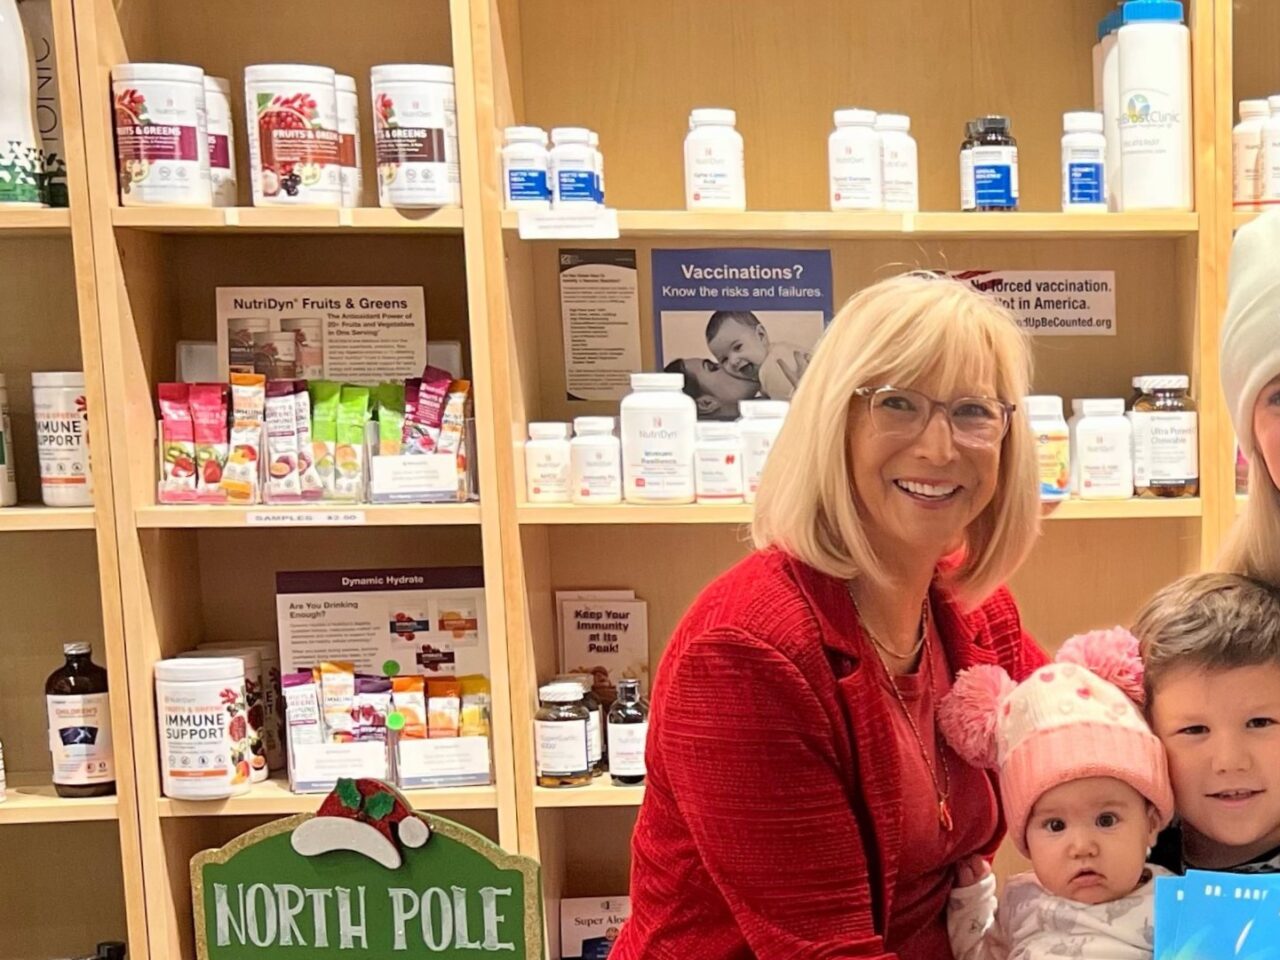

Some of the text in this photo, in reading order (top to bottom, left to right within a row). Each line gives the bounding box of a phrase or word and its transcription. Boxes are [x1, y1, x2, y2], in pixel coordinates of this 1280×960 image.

[144, 127, 181, 135] GREENS
[274, 129, 306, 139] FRUITS
[393, 130, 427, 139] GREENS
[681, 263, 804, 280] Vaccinations?
[992, 279, 1031, 292] forced
[1035, 279, 1112, 292] vaccination.
[662, 285, 697, 298] Know
[699, 286, 718, 297] the
[721, 285, 750, 297] risks
[752, 285, 775, 297] and
[302, 297, 341, 309] Fruits
[345, 298, 355, 309] &
[359, 298, 408, 309] Greens
[1018, 297, 1031, 310] in
[1034, 297, 1091, 310] America.
[638, 430, 677, 440] NutriDyn
[341, 575, 424, 587] Dynamic Hydrate
[289, 602, 304, 610] Are
[323, 600, 359, 610] Drinking
[574, 610, 630, 621] Keep Your
[576, 621, 629, 632] Immunity
[588, 643, 619, 653] Peak!
[165, 713, 225, 726] IMMUNE
[166, 727, 225, 740] SUPPORT
[213, 882, 516, 953] NORTH POLE
[574, 916, 604, 927] Super
